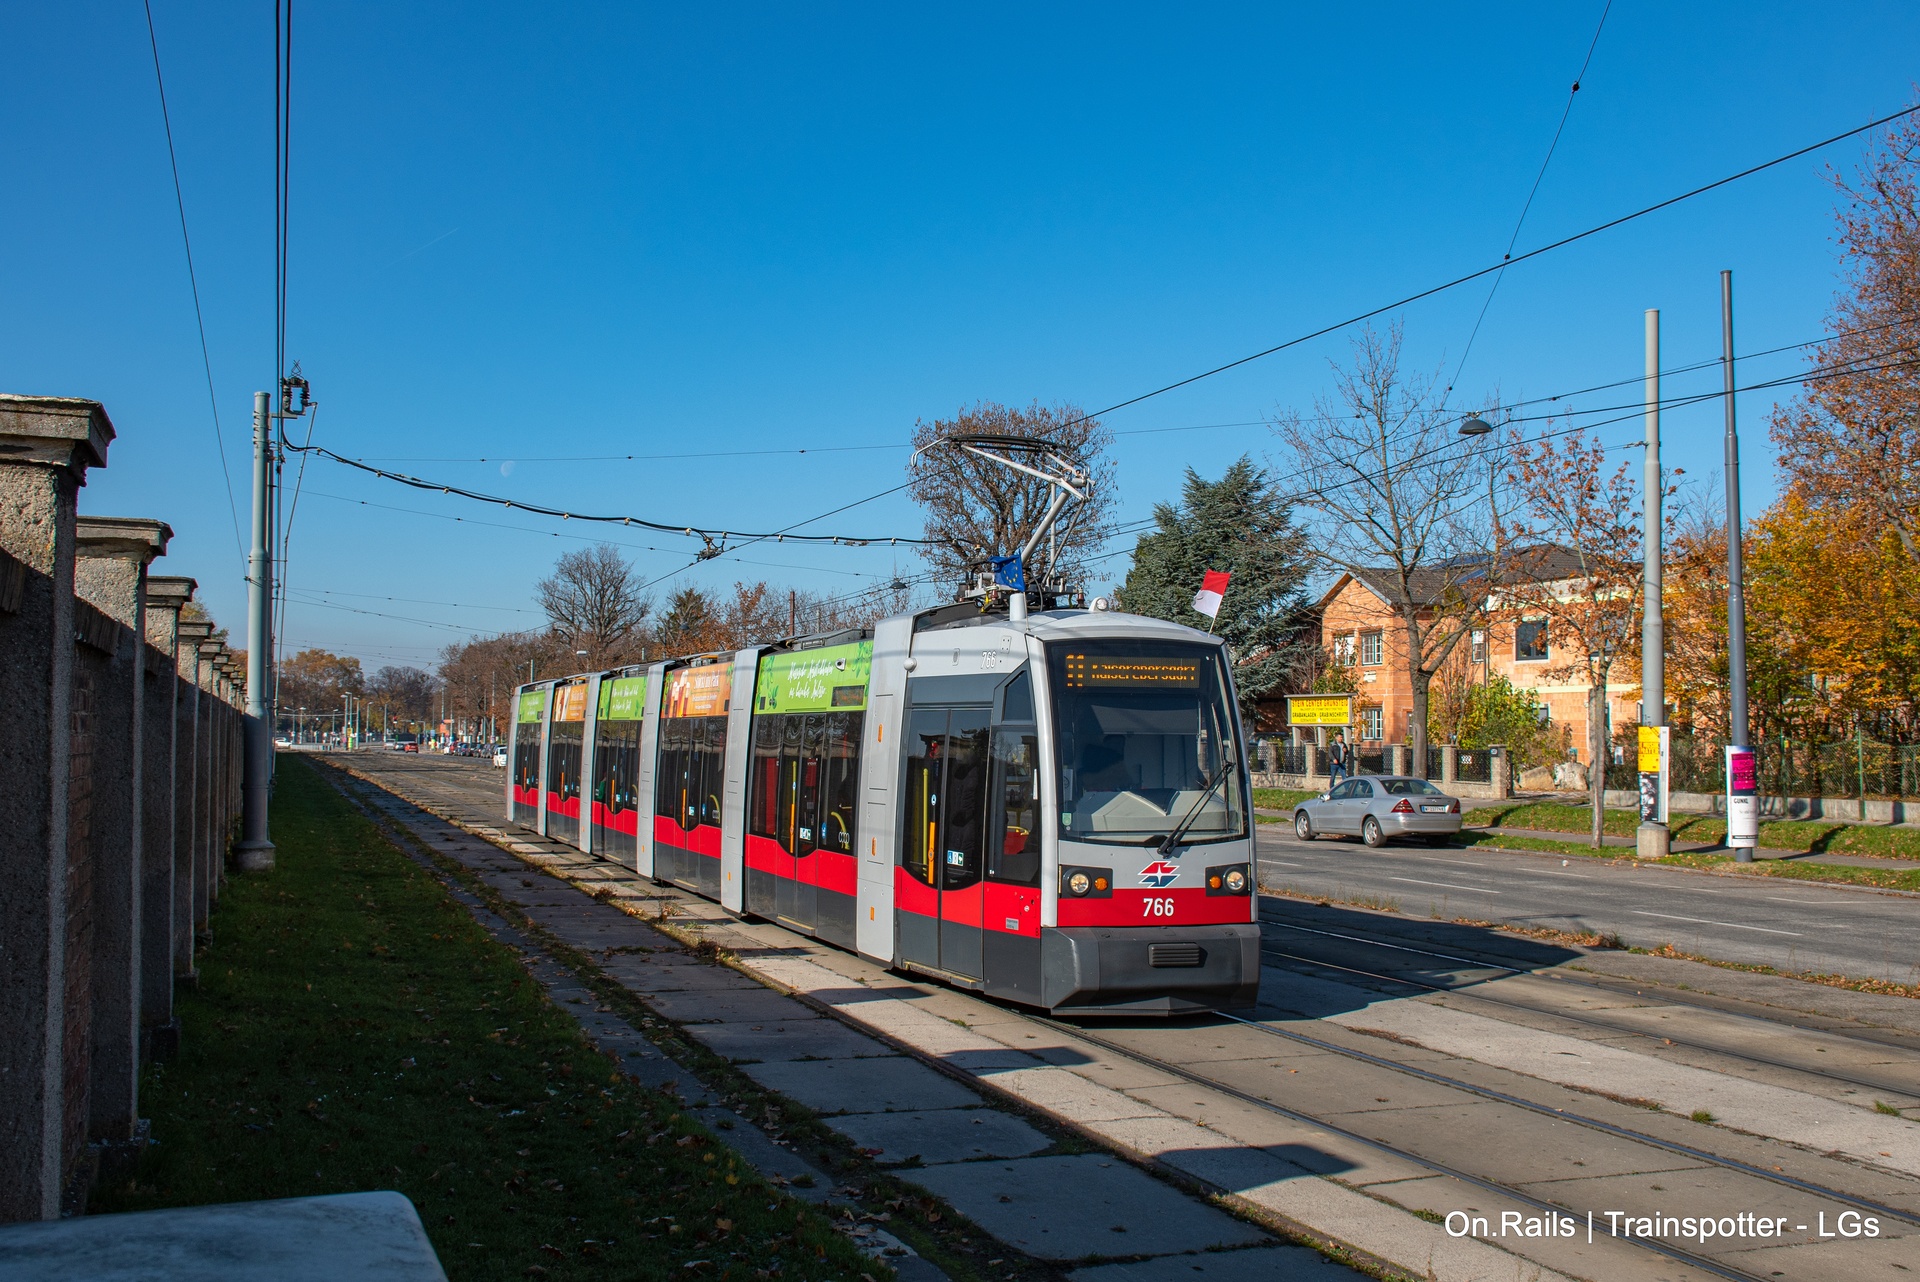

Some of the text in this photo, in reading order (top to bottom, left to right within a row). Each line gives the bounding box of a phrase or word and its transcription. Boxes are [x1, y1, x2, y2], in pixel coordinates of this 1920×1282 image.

[981, 650, 997, 669] 766
[1292, 699, 1305, 707] STEIN
[1143, 897, 1174, 917] 766
